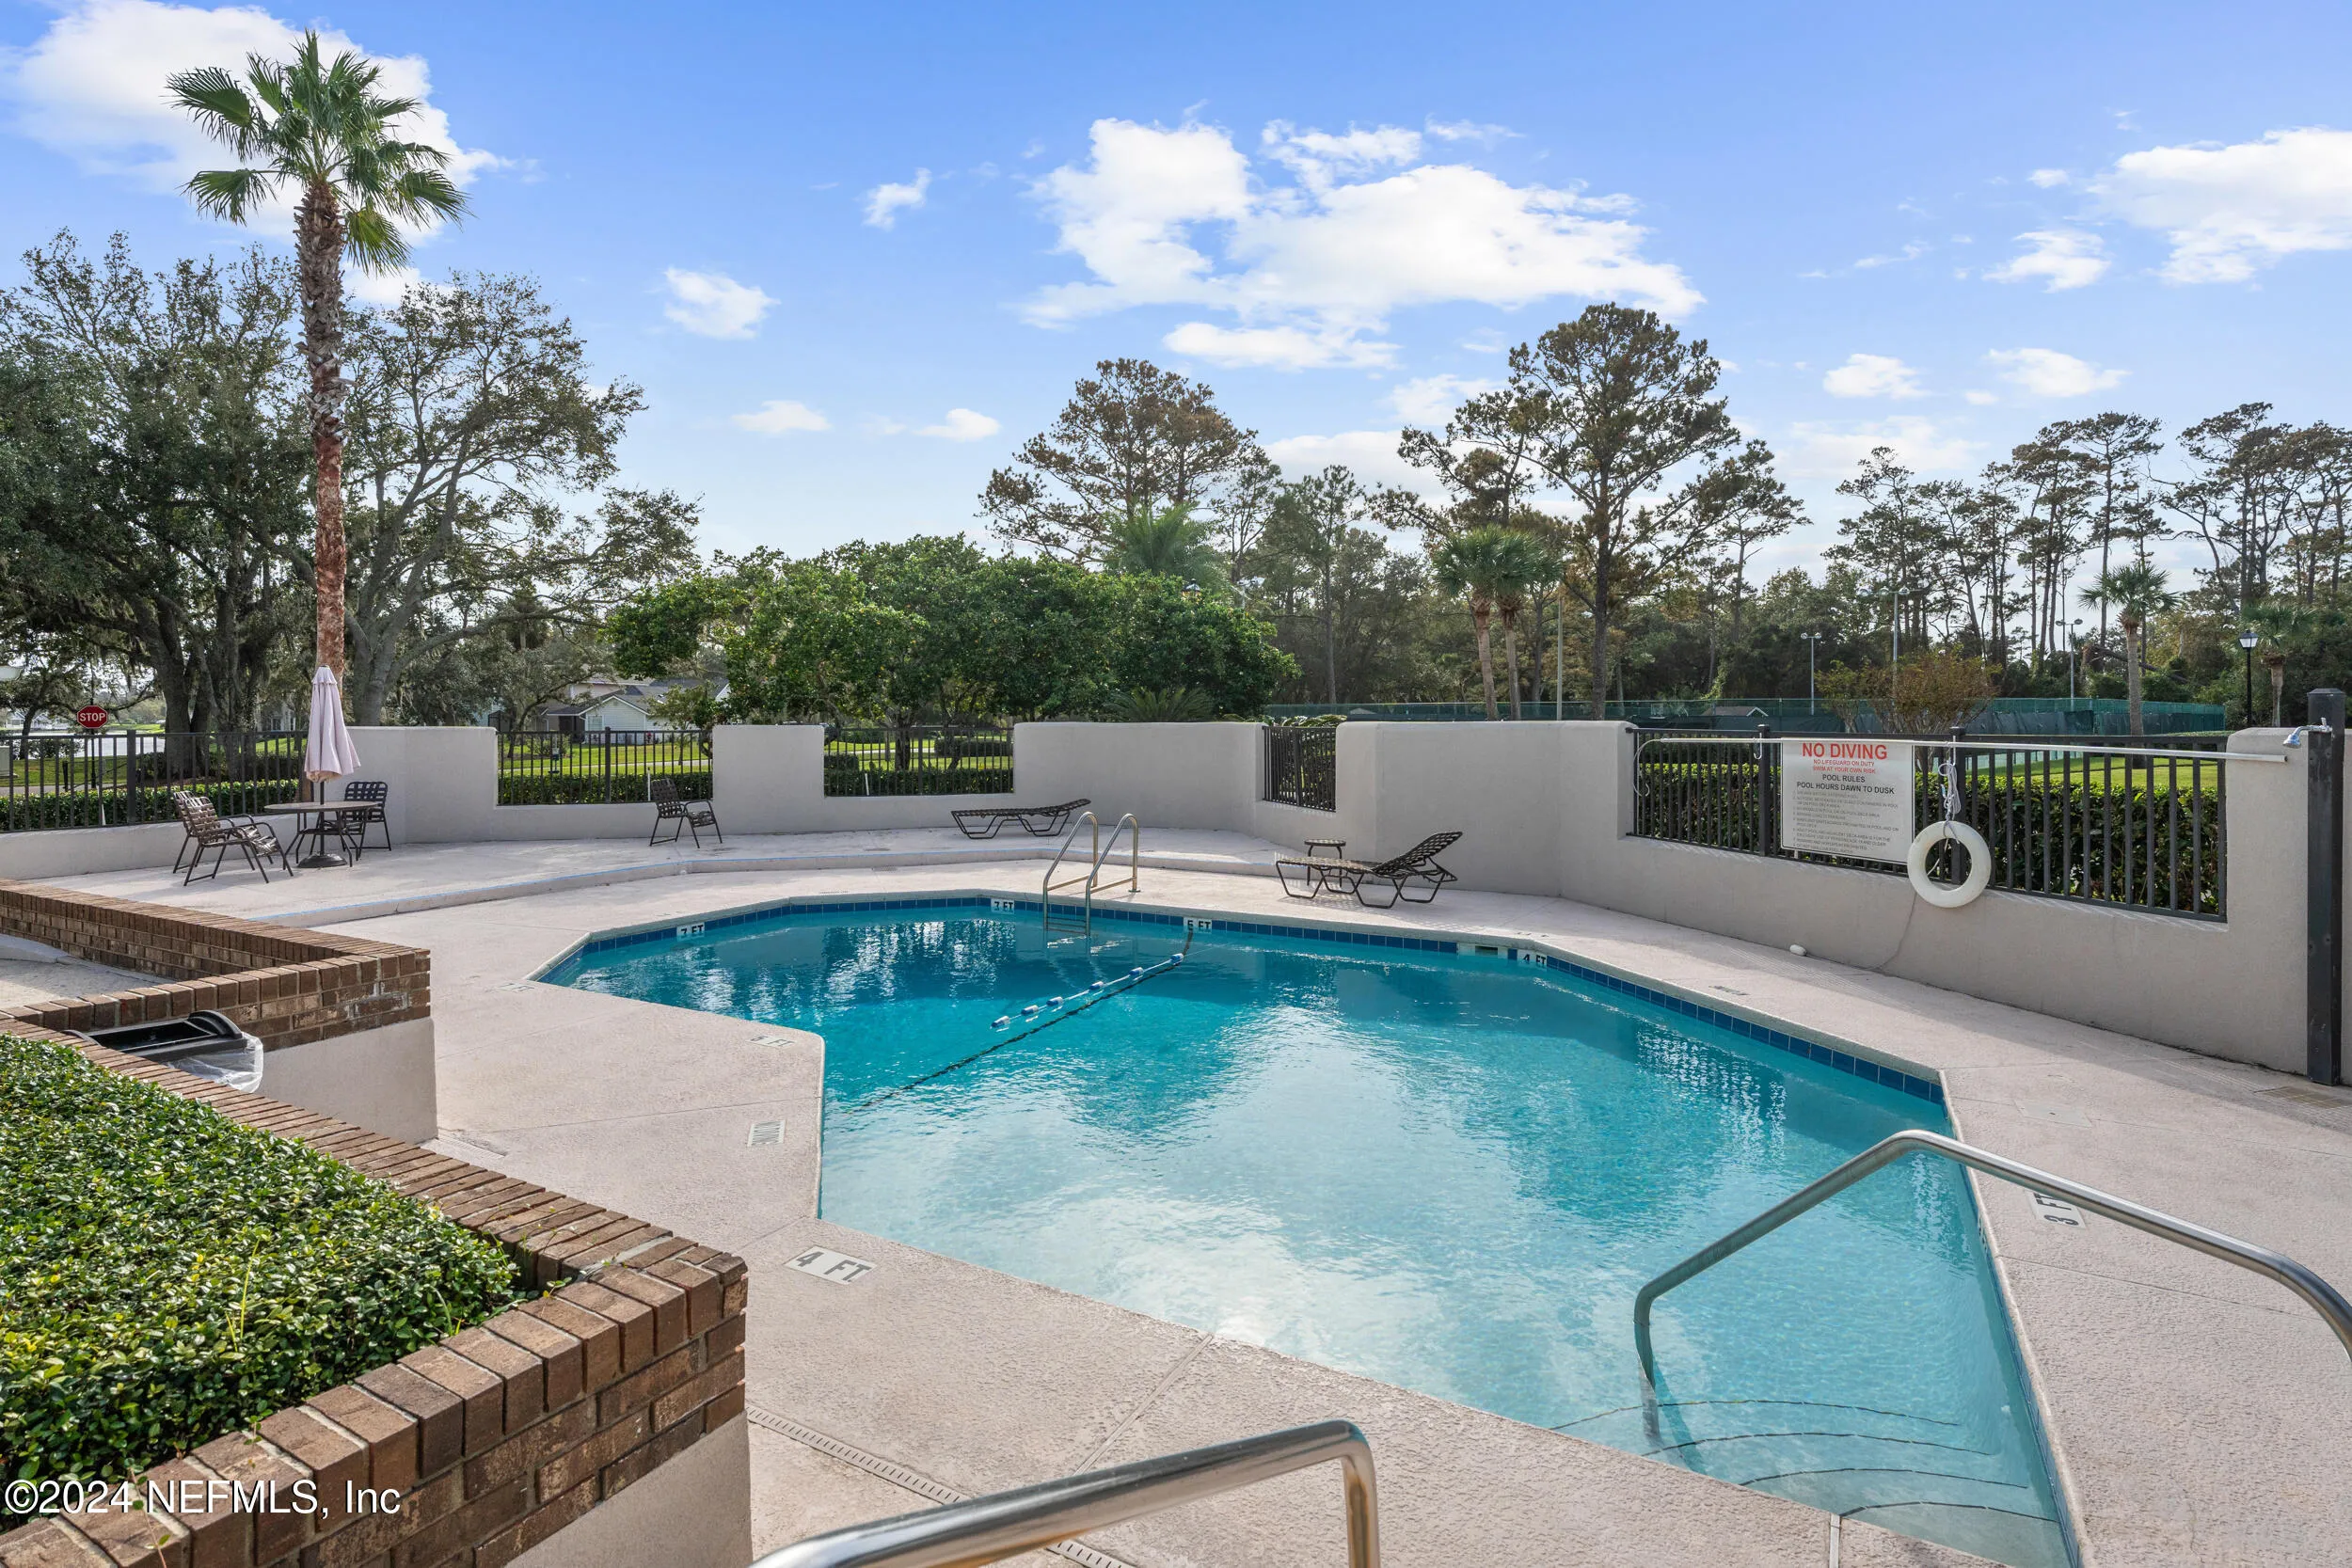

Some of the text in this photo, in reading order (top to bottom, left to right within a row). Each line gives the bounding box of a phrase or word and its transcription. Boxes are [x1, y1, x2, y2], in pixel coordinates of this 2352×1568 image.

[79, 712, 106, 721] STOP
[1802, 742, 1887, 760] NO DIVING
[1842, 775, 1866, 784] RULES
[1797, 782, 1815, 790] POOL
[1816, 783, 1839, 791] HOURS
[1841, 784, 1862, 792] DAWN
[1874, 786, 1895, 795] DUSK
[691, 924, 704, 934] FT
[1187, 920, 1211, 930] 5 FT
[1535, 954, 1547, 965] FT
[2033, 1192, 2079, 1226] 3 FT
[796, 1251, 872, 1281] 4 FT
